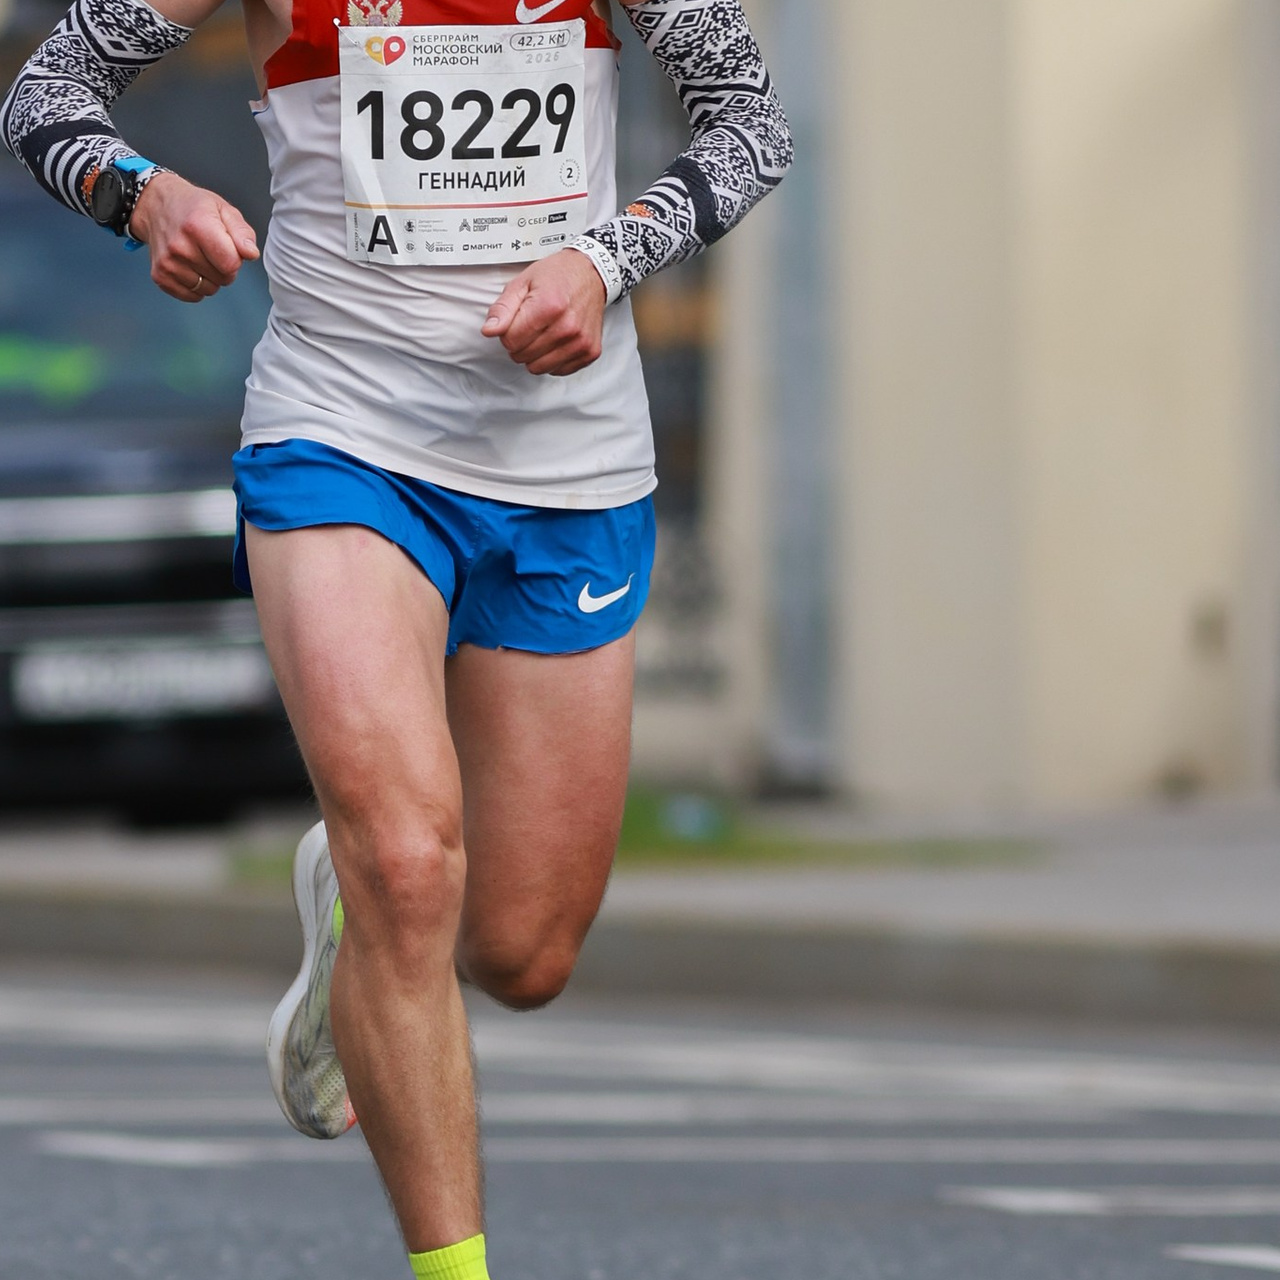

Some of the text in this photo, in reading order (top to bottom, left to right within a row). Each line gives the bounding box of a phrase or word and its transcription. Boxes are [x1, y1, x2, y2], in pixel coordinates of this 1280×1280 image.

[413, 33, 479, 43] СБЕРПРАЙМ
[517, 33, 565, 48] 42,2 КМ
[412, 42, 503, 55] МОСКОВСКИЙ
[413, 55, 479, 66] МАРАФОН
[357, 83, 576, 161] 18229
[418, 166, 526, 192] ГЕННАДИЙ
[566, 167, 573, 179] 2
[528, 216, 547, 225] СБЕР
[598, 251, 616, 275] 42,2
[611, 276, 619, 286] К
